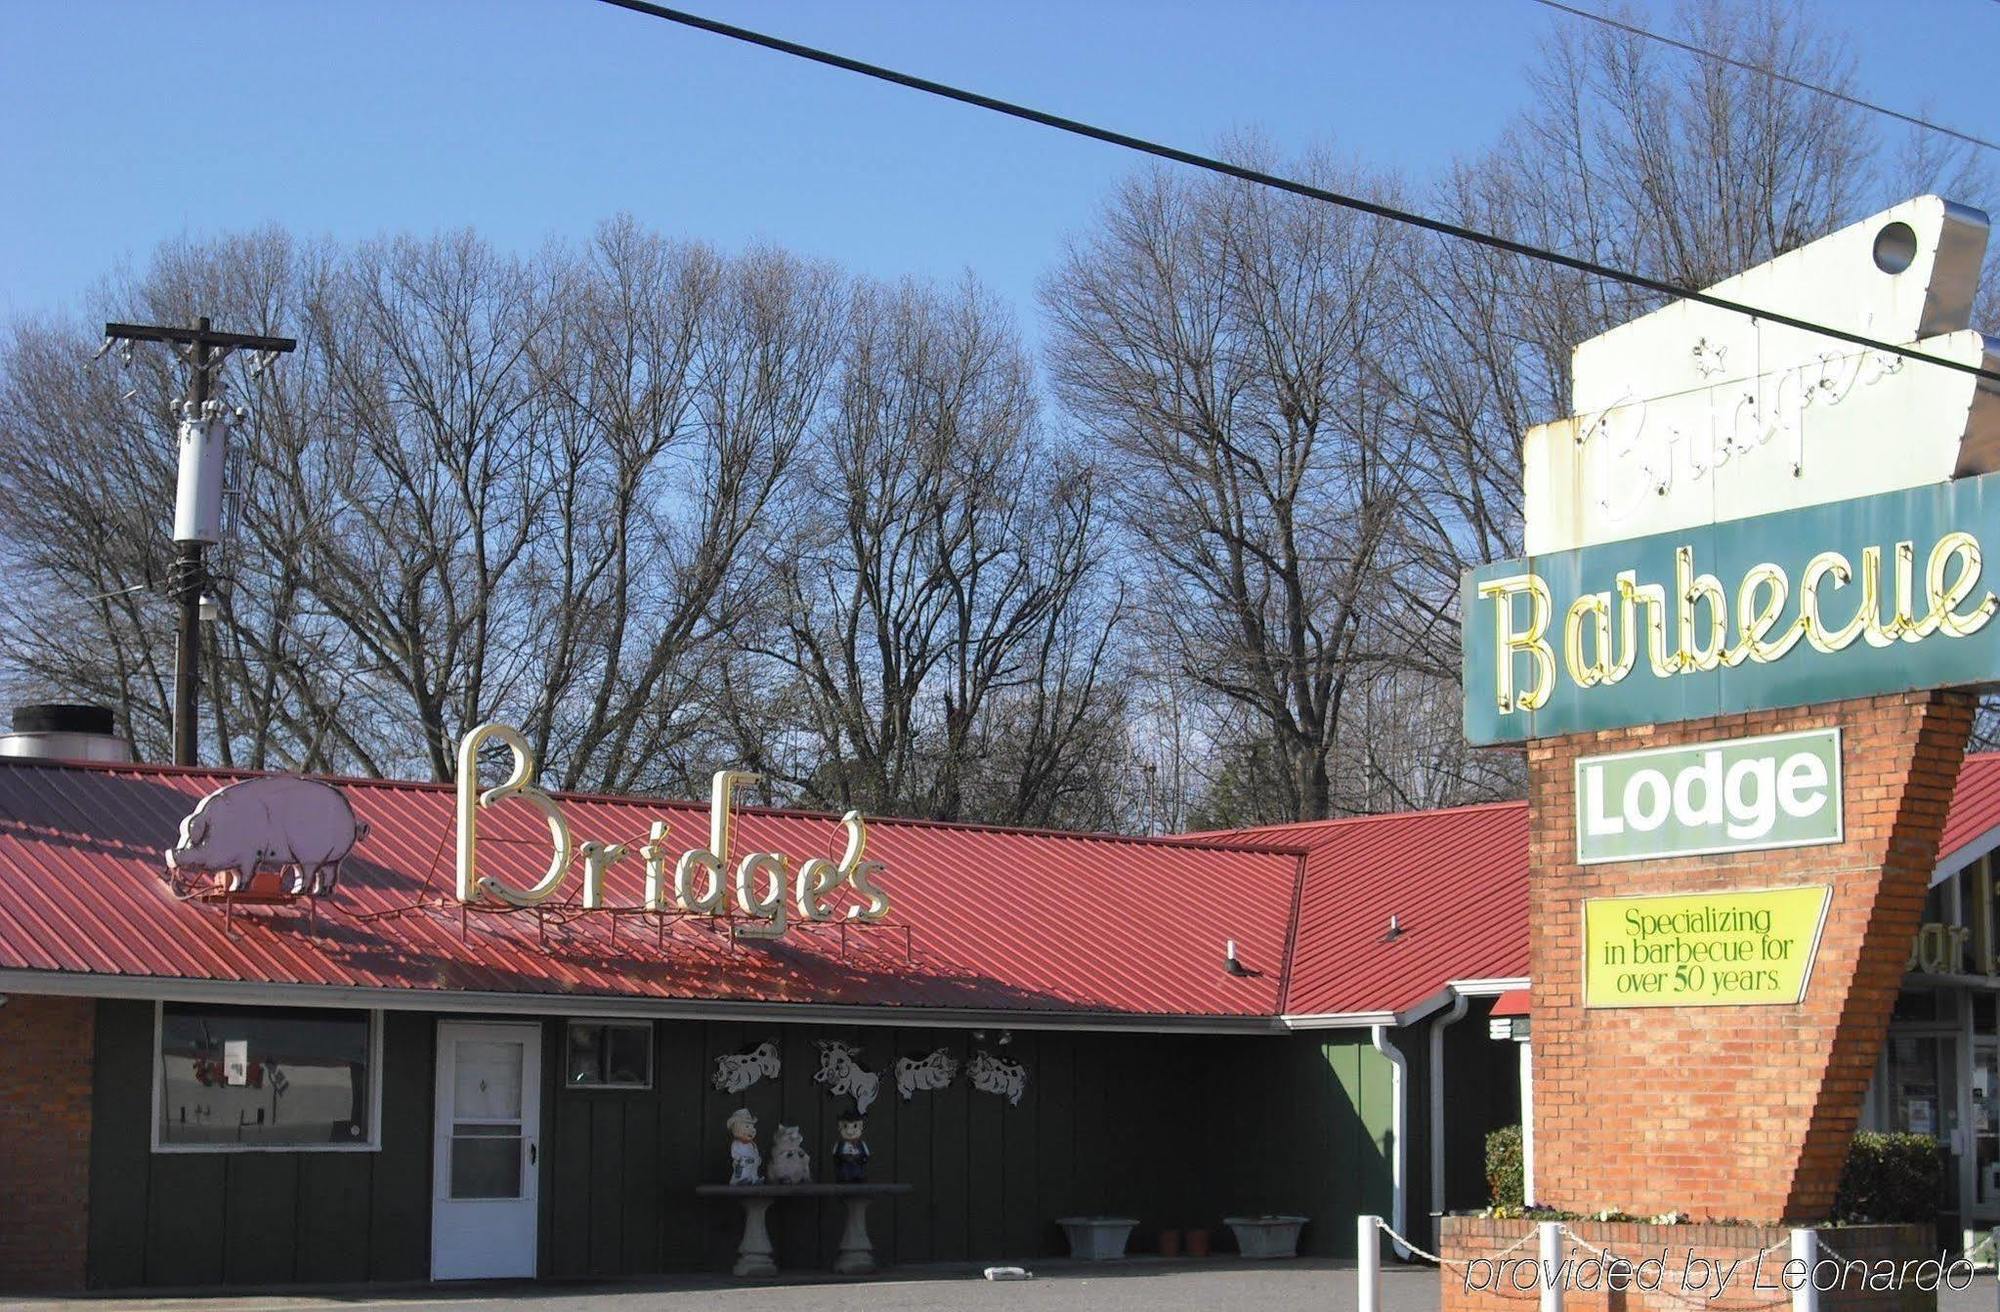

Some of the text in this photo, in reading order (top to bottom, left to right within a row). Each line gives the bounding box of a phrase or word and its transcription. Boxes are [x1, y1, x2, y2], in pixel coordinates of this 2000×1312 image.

[1478, 531, 1999, 715] Barbecue
[1584, 750, 1829, 838] Lodge
[1625, 906, 1771, 940] Specializing
[1604, 934, 1794, 965] in barbecue for
[1617, 972, 1668, 993] over
[1674, 965, 1705, 992] 50
